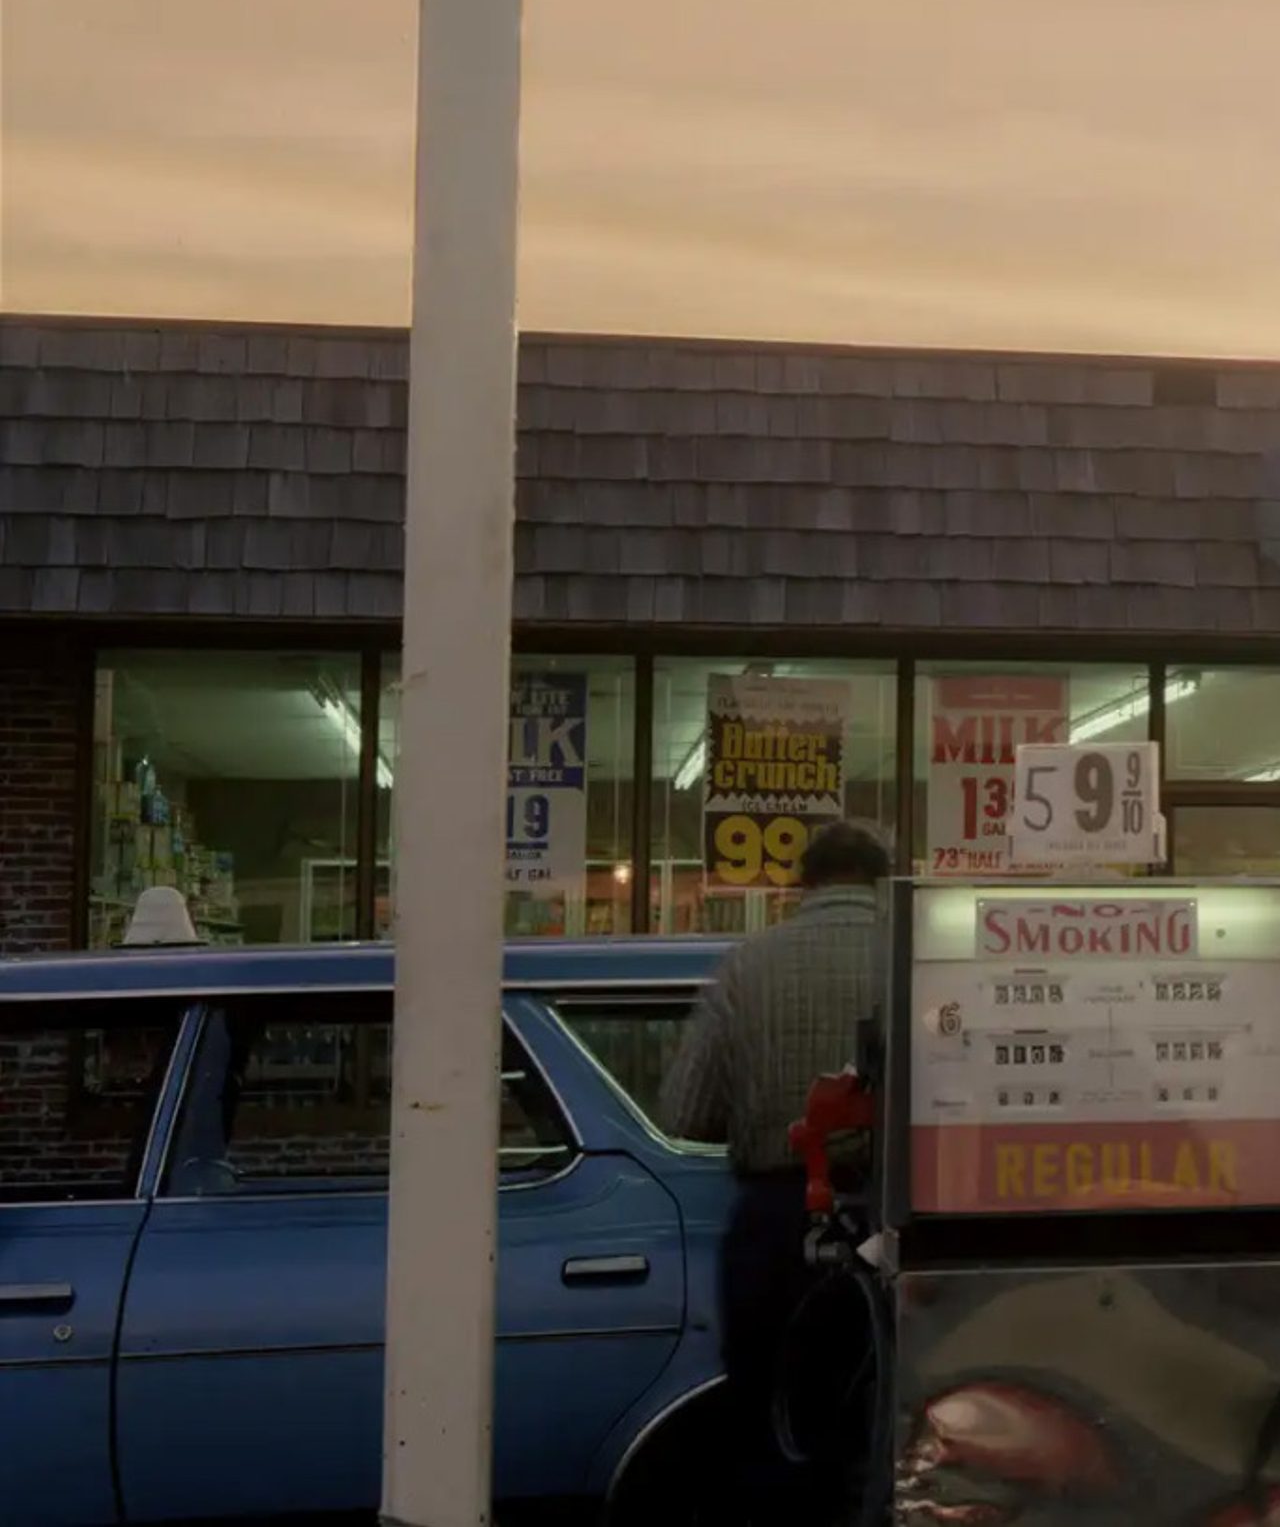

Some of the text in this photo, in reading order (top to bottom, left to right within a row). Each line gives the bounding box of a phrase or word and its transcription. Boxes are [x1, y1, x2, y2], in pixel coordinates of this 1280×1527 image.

[509, 717, 584, 767] LK
[722, 723, 826, 760] Butter
[931, 716, 1070, 764] MILK
[714, 755, 837, 791] crunch
[983, 907, 1192, 955] SMOKING
[1051, 903, 1122, 917] NO
[993, 1141, 1239, 1200] REGULAR
